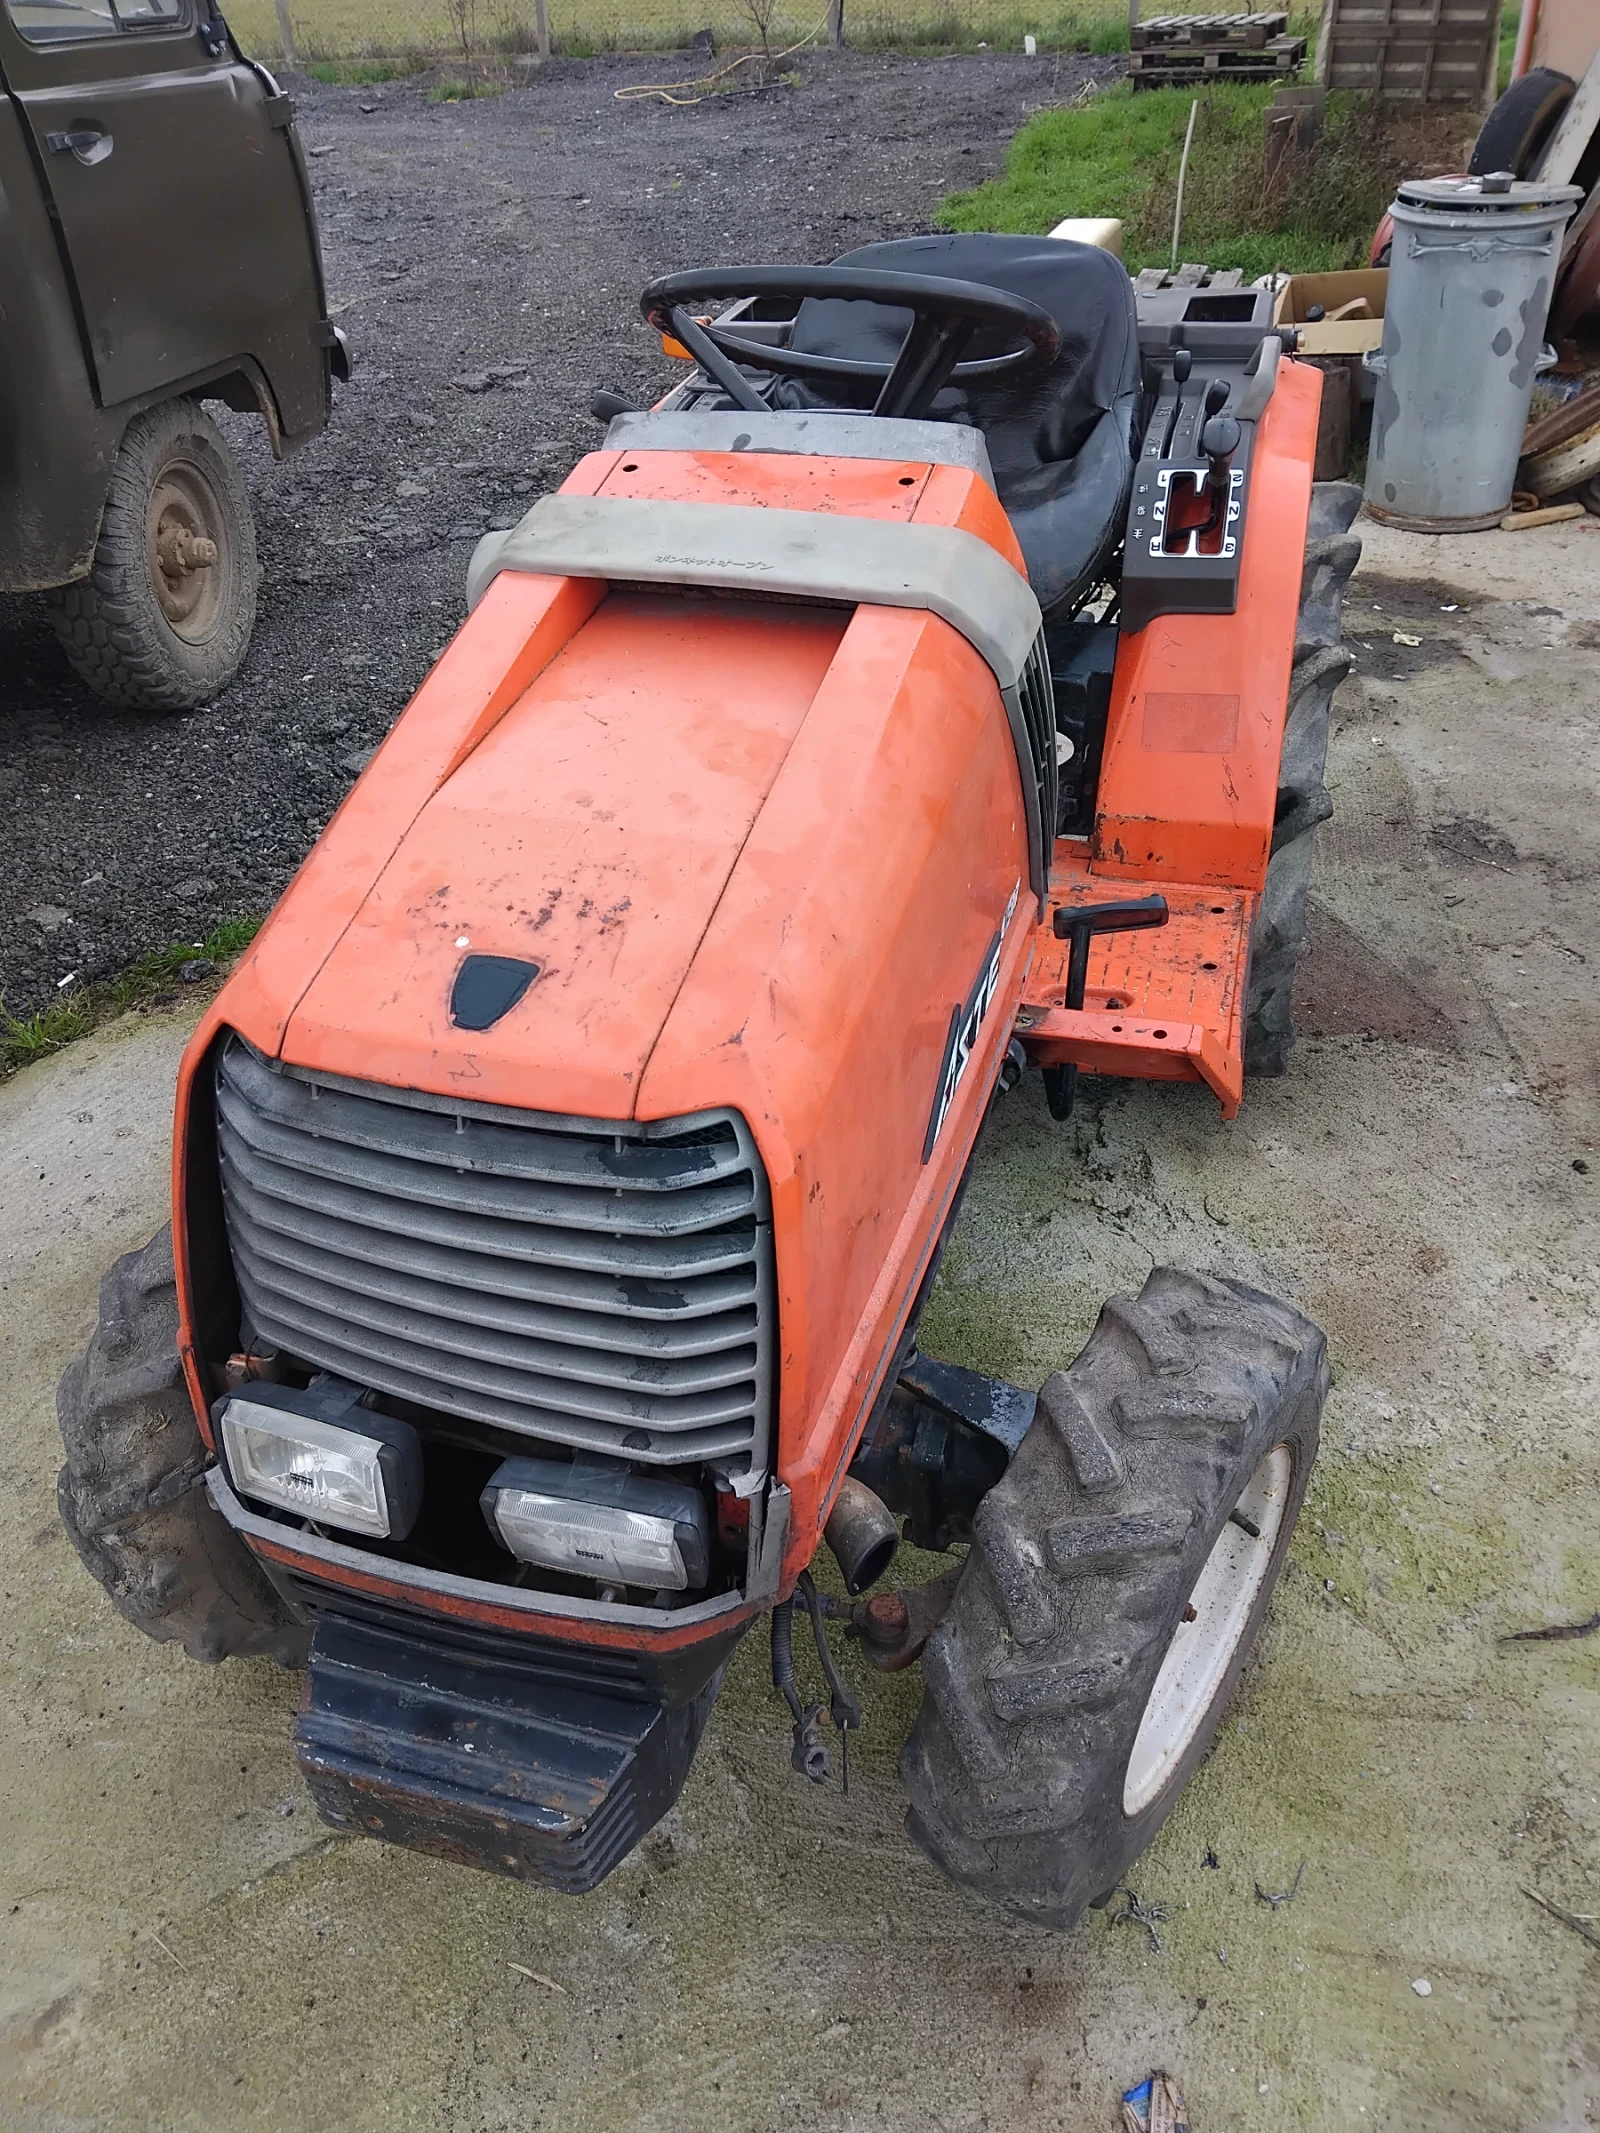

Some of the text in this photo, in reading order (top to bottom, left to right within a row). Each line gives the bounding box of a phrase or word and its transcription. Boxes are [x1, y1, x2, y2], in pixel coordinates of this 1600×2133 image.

[1232, 473, 1243, 482] 2
[1154, 505, 1165, 516] N
[1228, 505, 1239, 516] N
[1150, 541, 1161, 552] R
[1224, 542, 1235, 553] 3
